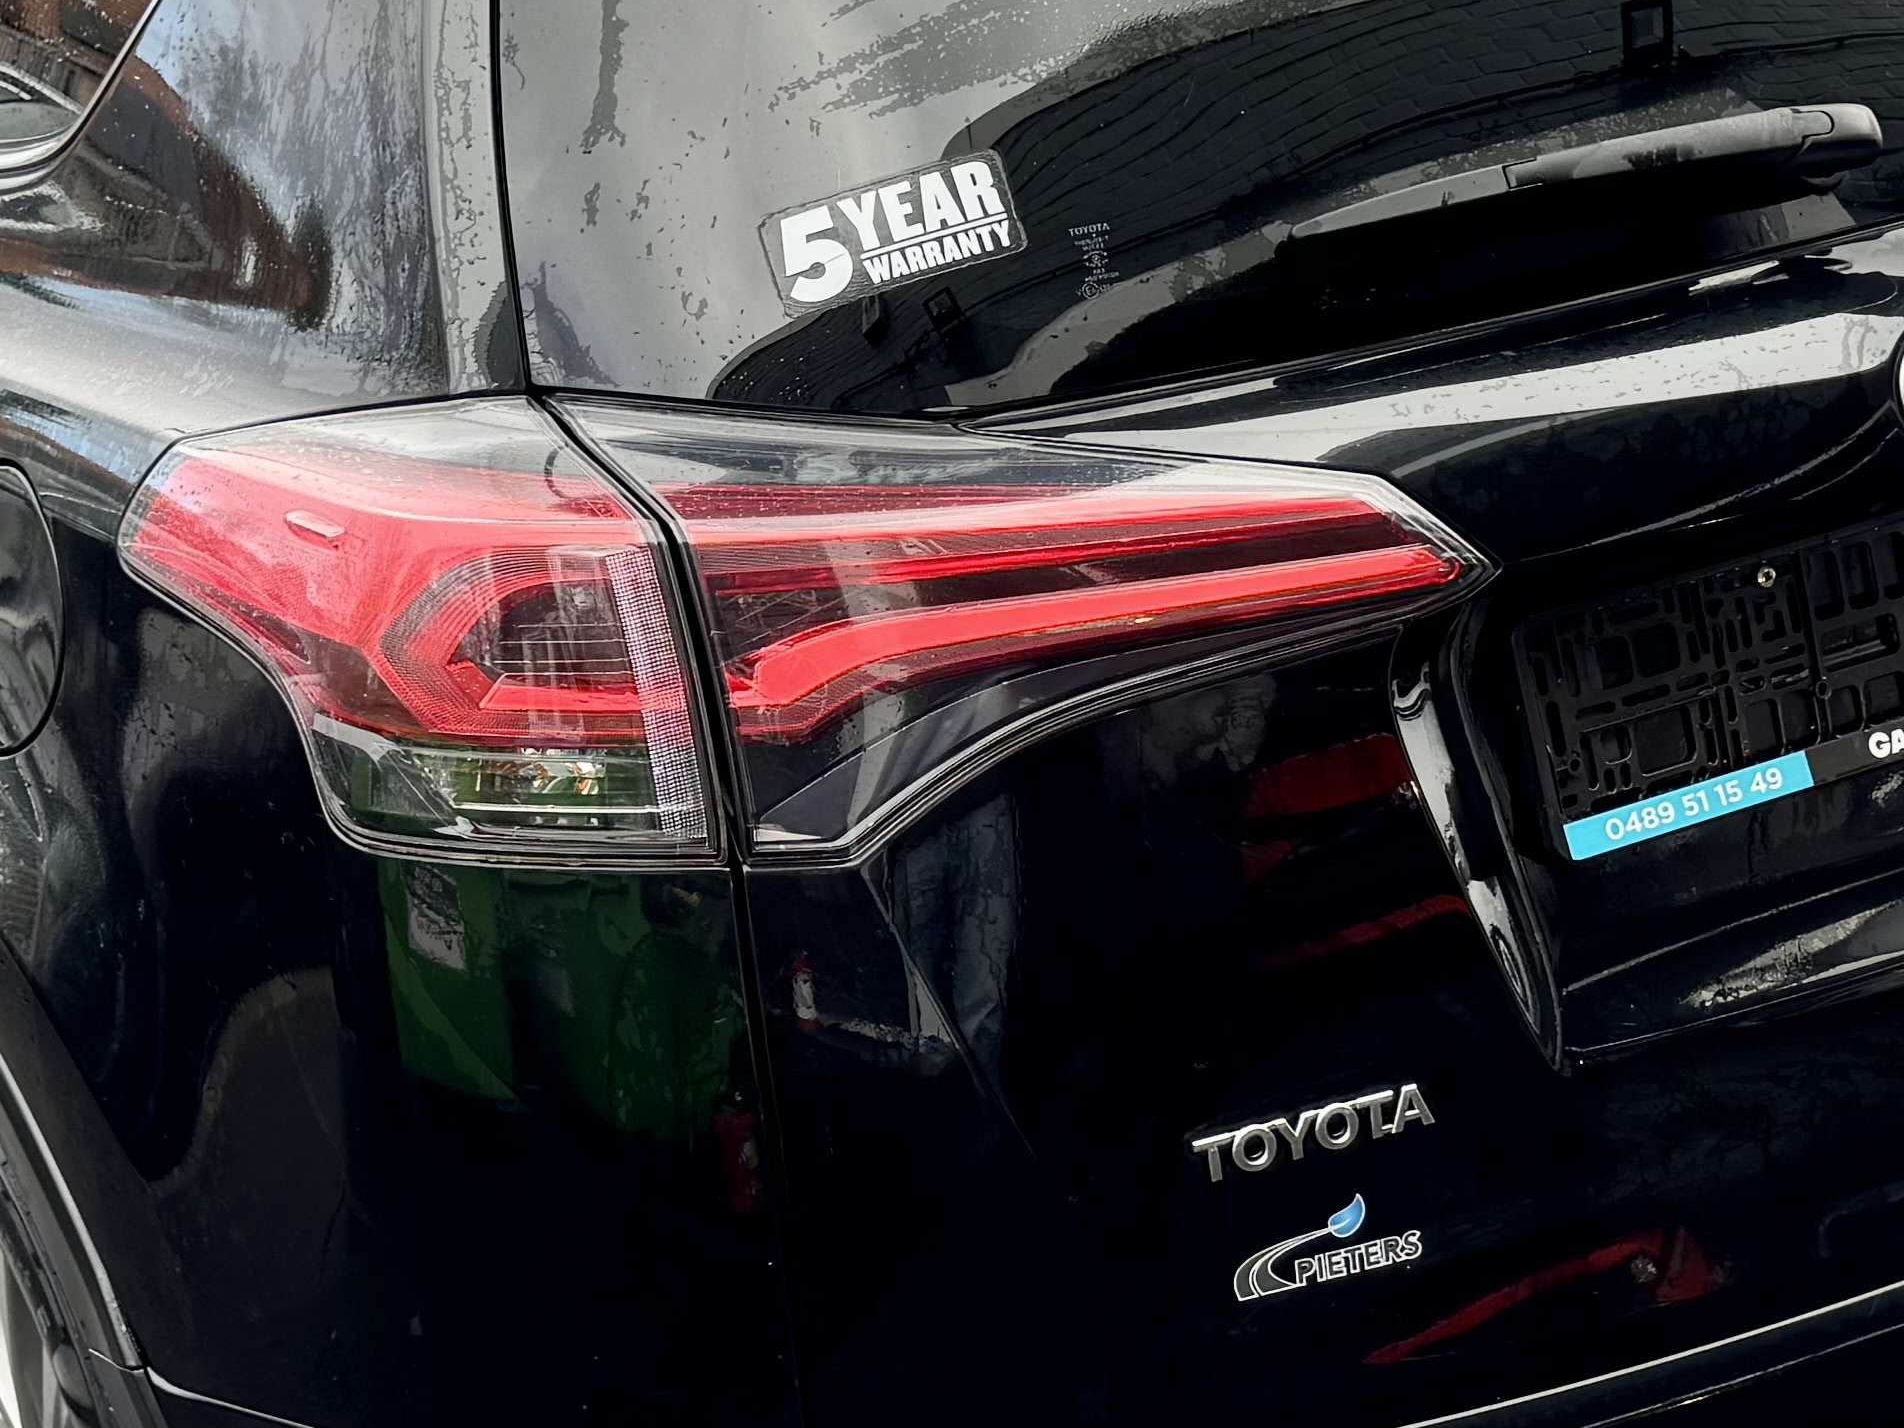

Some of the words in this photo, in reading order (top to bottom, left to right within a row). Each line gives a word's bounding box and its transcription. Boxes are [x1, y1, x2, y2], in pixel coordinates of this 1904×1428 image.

[780, 205, 853, 302] 5
[837, 161, 1006, 251] YEAR
[863, 220, 1010, 284] WARRANTY
[1068, 223, 1110, 236] TOYOTA
[1605, 800, 1675, 841] 0489
[1682, 790, 1711, 817] 51
[1715, 780, 1743, 806] 15
[1749, 767, 1783, 794] 49
[1192, 1083, 1435, 1182] TOYOTA
[1294, 1230, 1422, 1286] PIETERS
